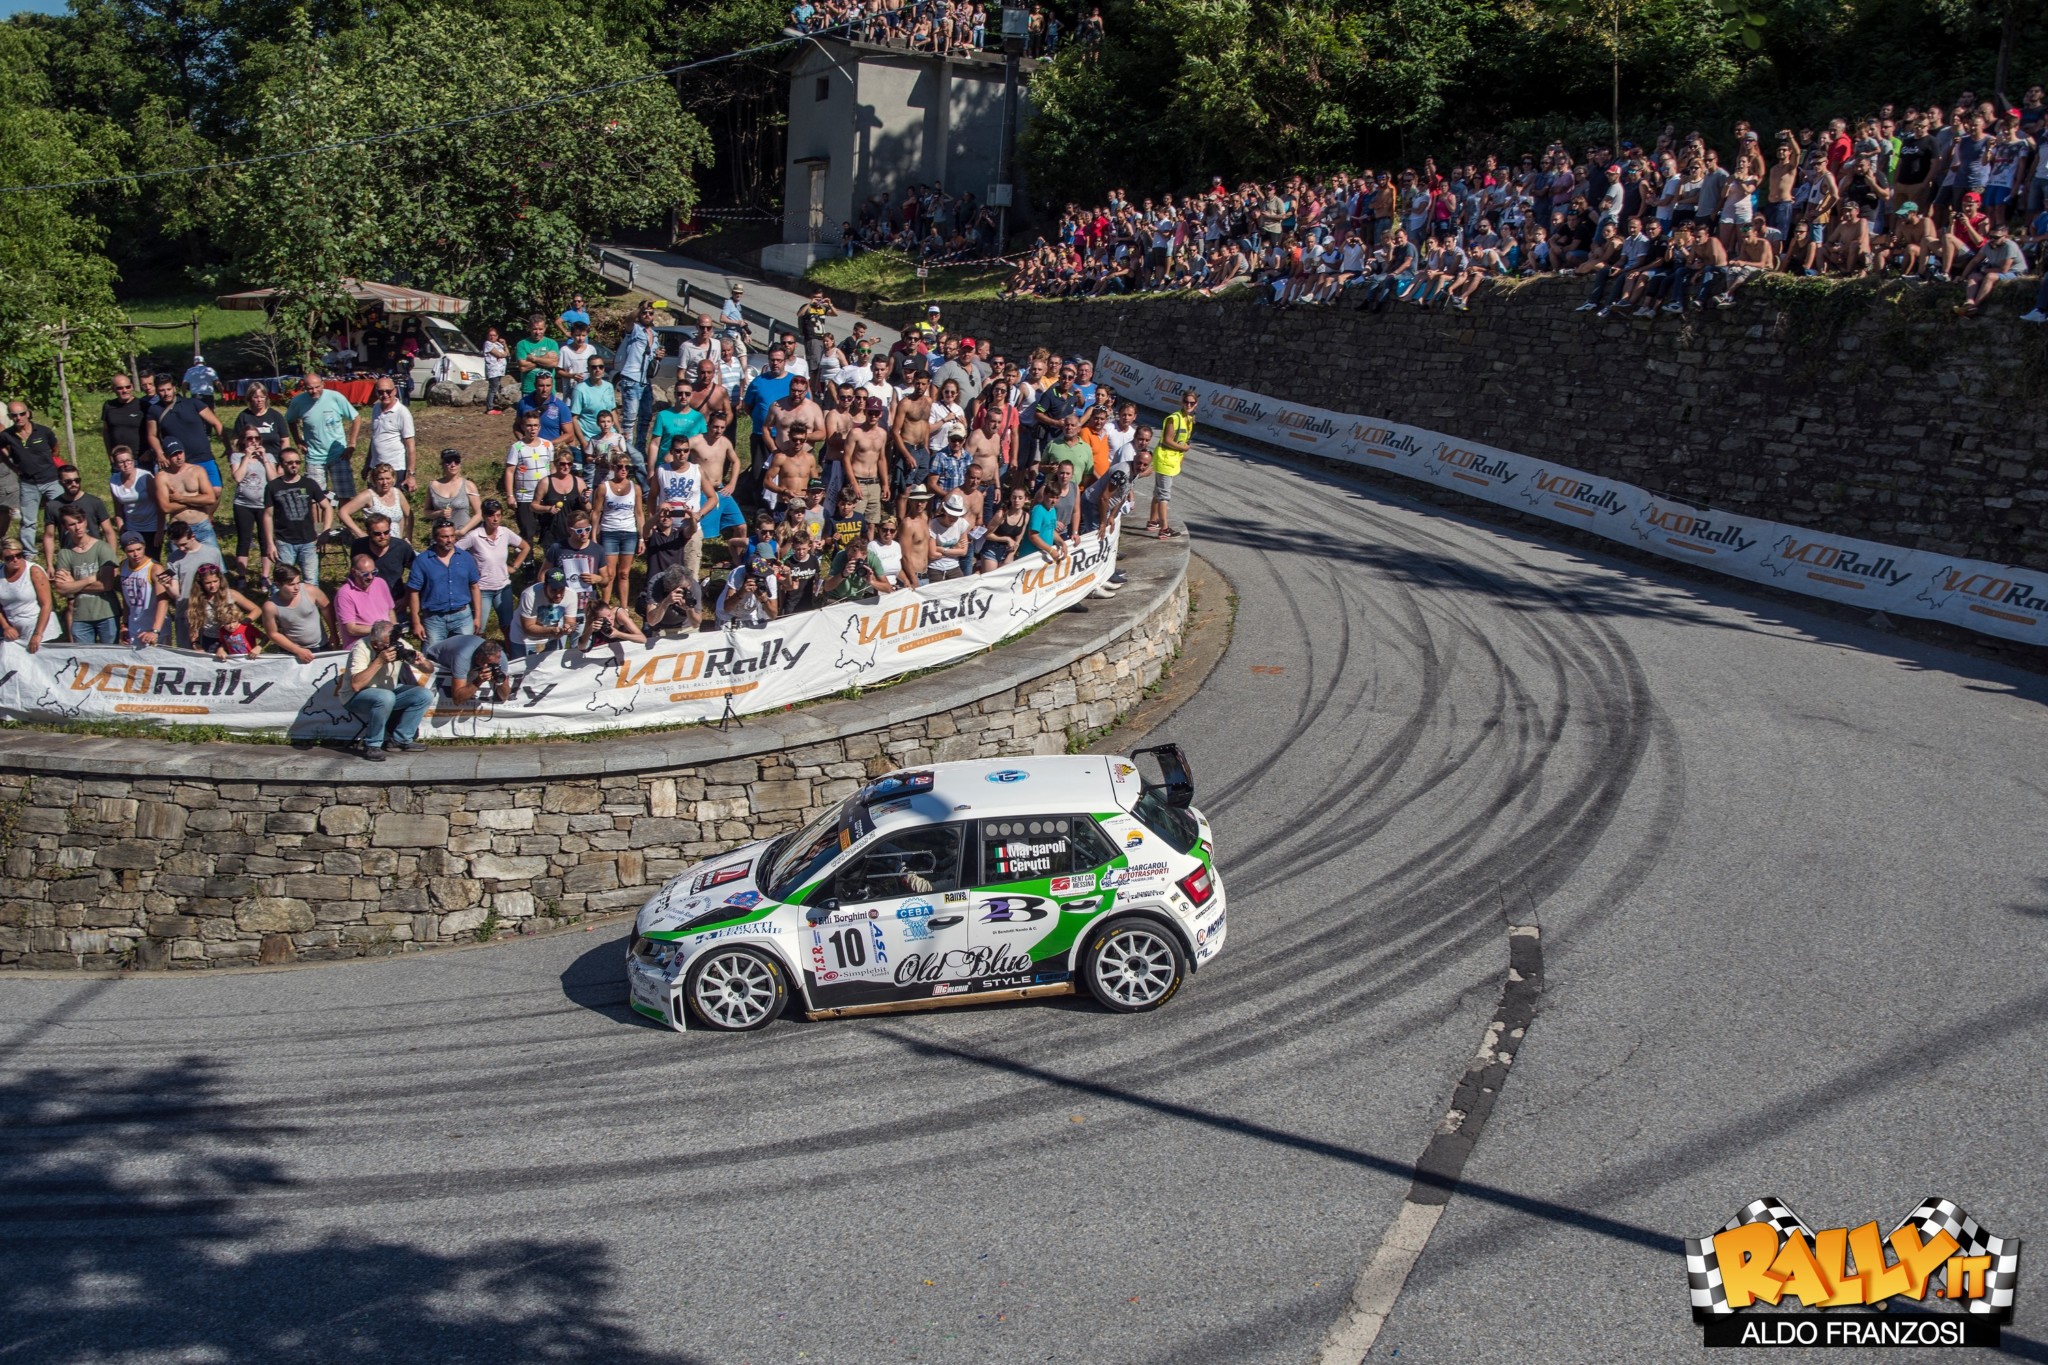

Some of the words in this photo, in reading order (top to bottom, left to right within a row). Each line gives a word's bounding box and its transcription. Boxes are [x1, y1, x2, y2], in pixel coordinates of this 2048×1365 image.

[1211, 392, 1268, 421] VCORally
[1278, 409, 1339, 439] VCORally
[1353, 425, 1422, 457] VCORally
[1438, 446, 1519, 484] VCORally
[1536, 472, 1627, 515] VCORally
[836, 521, 862, 532] GOALS
[1646, 507, 1757, 552] VCORally
[1782, 540, 1912, 587] VCORally
[858, 590, 994, 645] VCORally
[615, 638, 811, 688] VCORally
[70, 662, 274, 704] VCORally
[1007, 841, 1066, 858] Margaroli
[1009, 857, 1050, 872] Cerutti
[1071, 875, 1083, 883] RENT
[1084, 874, 1095, 882] CAR
[1118, 868, 1169, 880] AUTOTRASPORTI
[1128, 862, 1167, 872] MARGAROLI
[1072, 880, 1095, 889] MESSINA
[834, 911, 868, 923] Borghini
[900, 907, 930, 918] CEBA
[829, 928, 866, 968] 10
[843, 967, 887, 978] Simplebit
[893, 952, 947, 987] Old
[952, 943, 1031, 978] Blue
[982, 975, 1031, 988] STYLE
